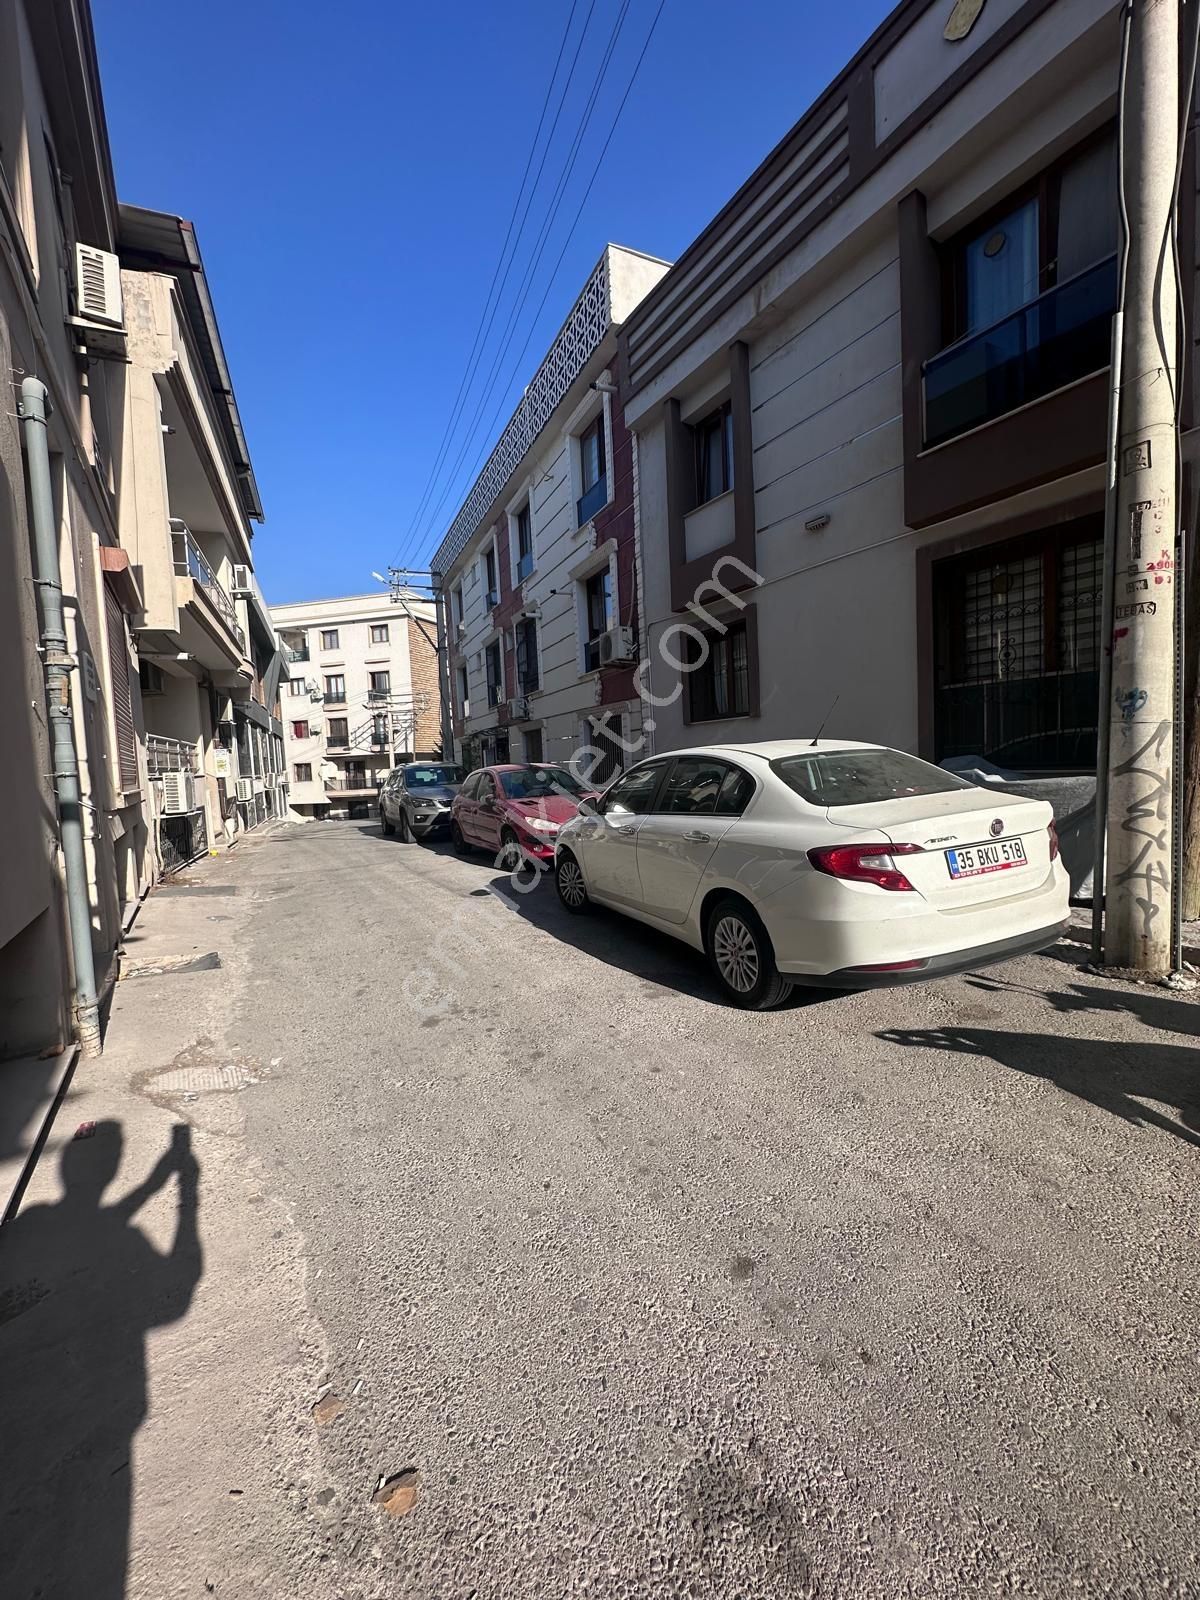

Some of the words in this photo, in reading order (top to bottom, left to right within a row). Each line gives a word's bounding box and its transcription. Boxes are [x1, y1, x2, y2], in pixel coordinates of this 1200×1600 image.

[957, 850, 974, 870] 35
[977, 846, 999, 865] BKU
[1002, 842, 1022, 860] 518
